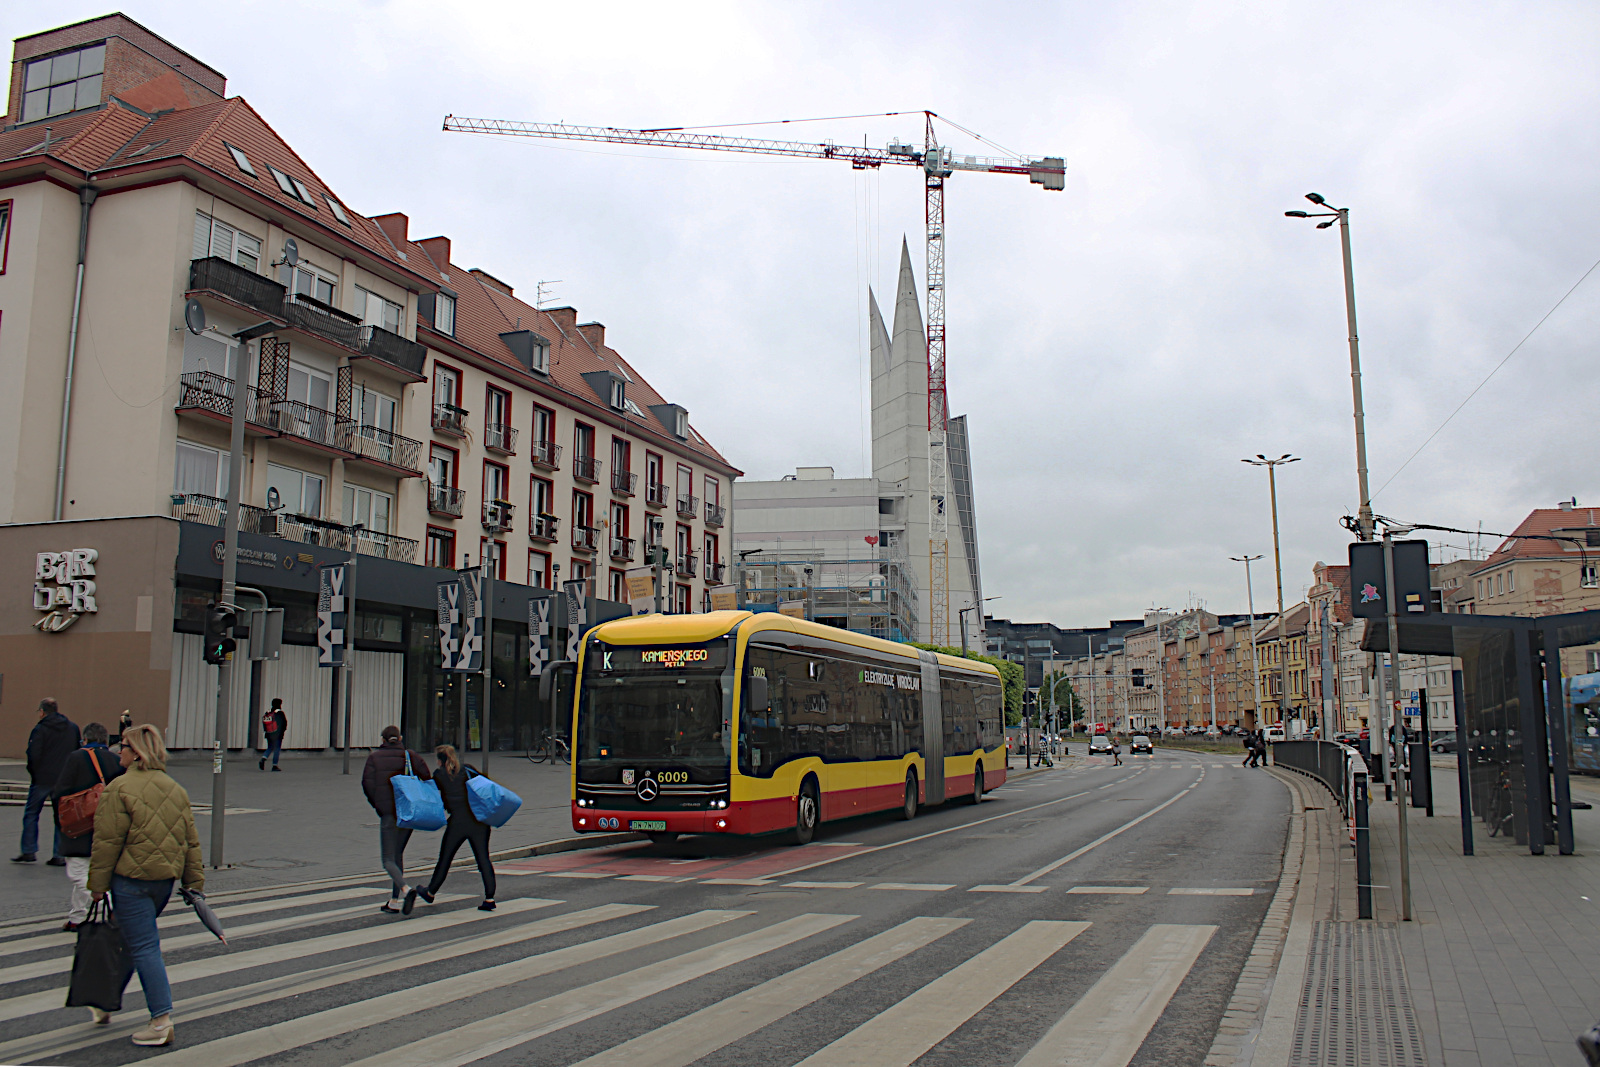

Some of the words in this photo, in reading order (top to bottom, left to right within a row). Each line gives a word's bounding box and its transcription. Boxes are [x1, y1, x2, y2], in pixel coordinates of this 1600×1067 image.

[236, 547, 263, 559] ROCŁAW
[603, 651, 612, 669] K
[641, 650, 707, 662] KAMIEŃSKIEGO
[864, 671, 895, 689] ELEKTRYZUJĘ
[896, 674, 920, 691] WROCŁAW
[657, 771, 688, 783] 6009
